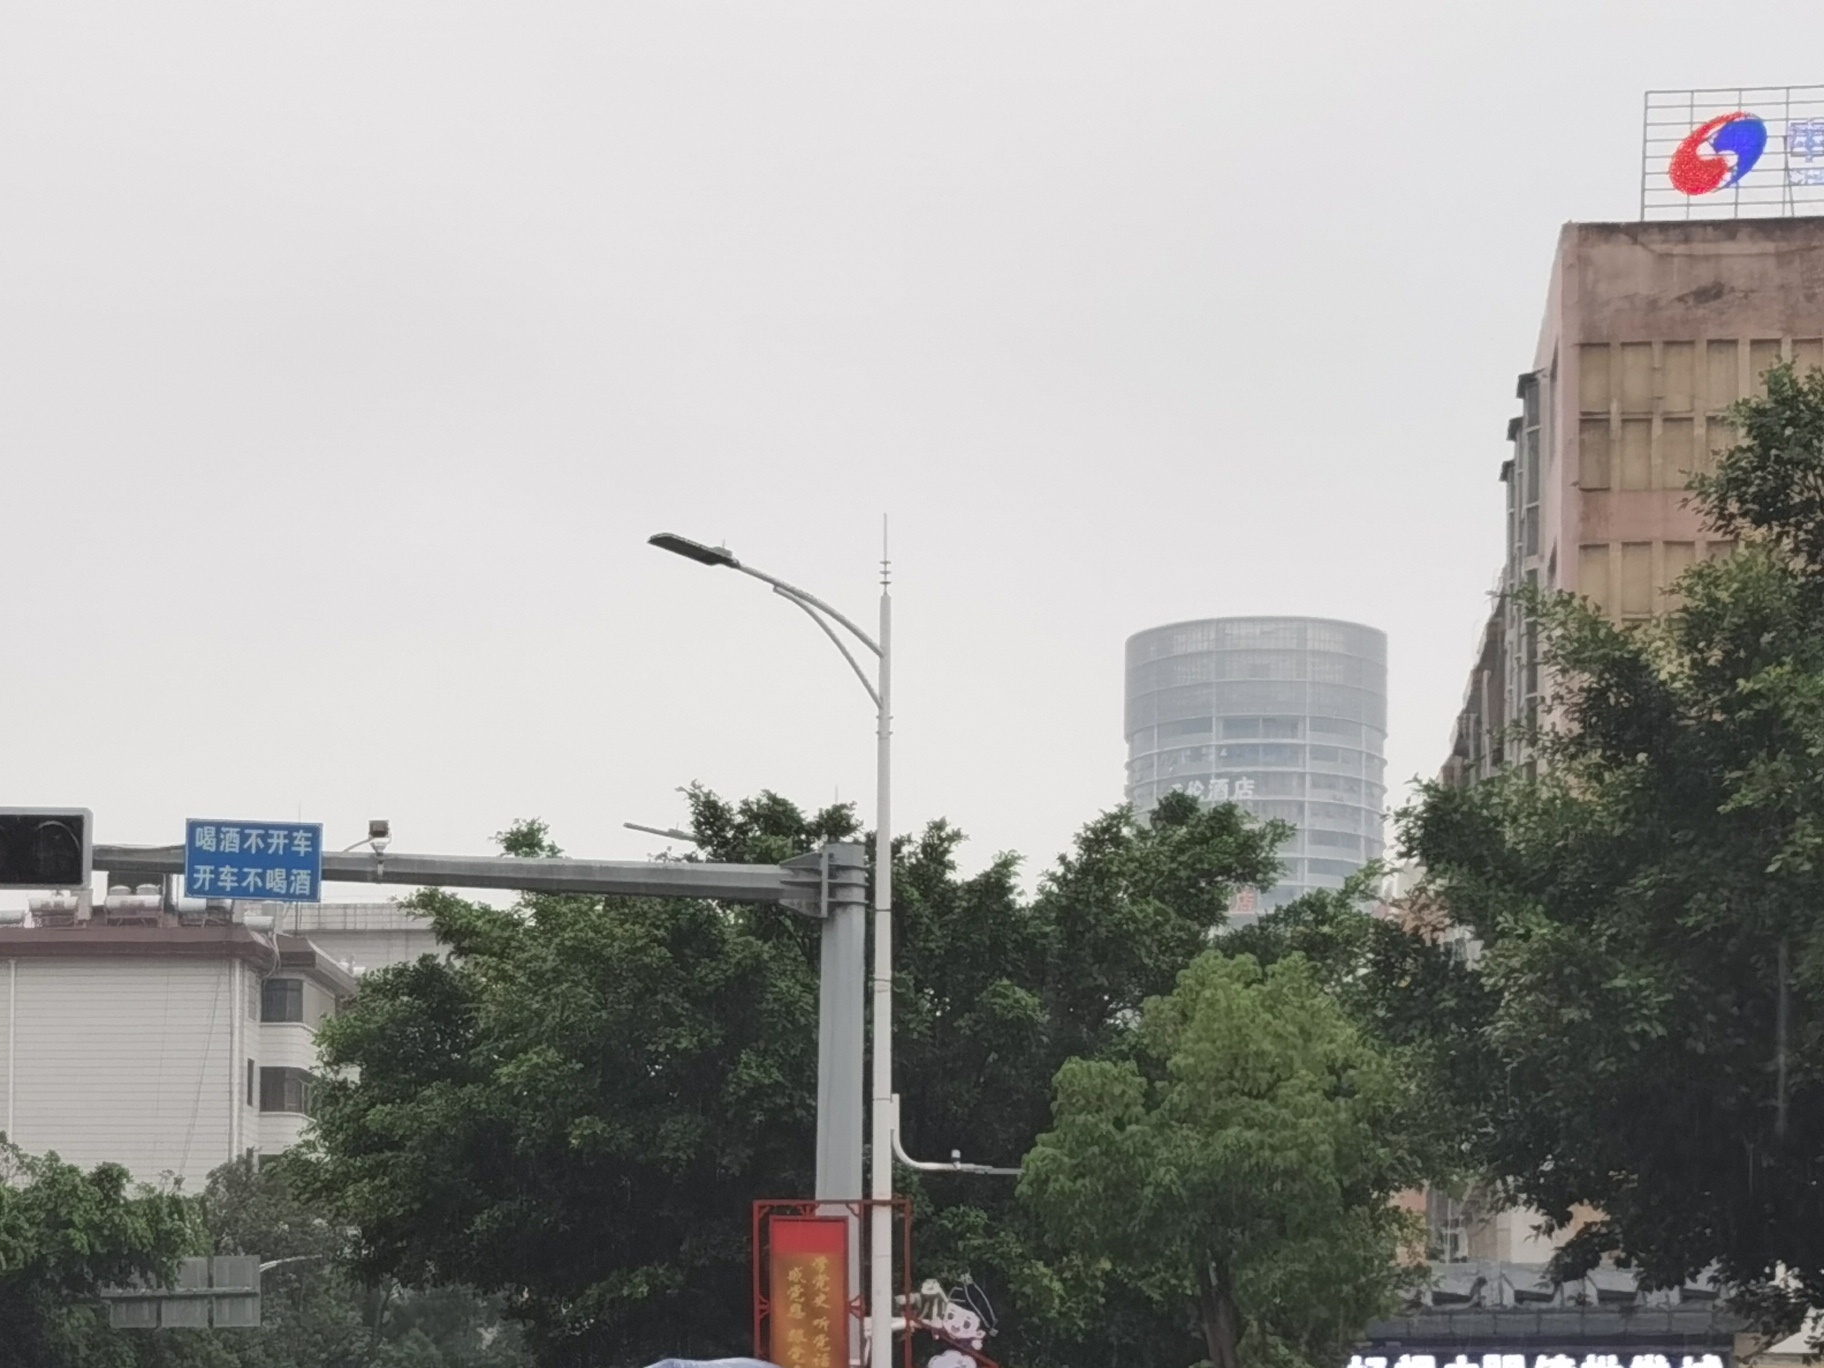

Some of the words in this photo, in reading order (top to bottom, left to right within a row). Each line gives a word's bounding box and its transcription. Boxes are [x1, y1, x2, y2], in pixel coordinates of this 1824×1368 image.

[195, 826, 313, 857] 喝酒不开车
[193, 864, 312, 896] 开车不喝酒
